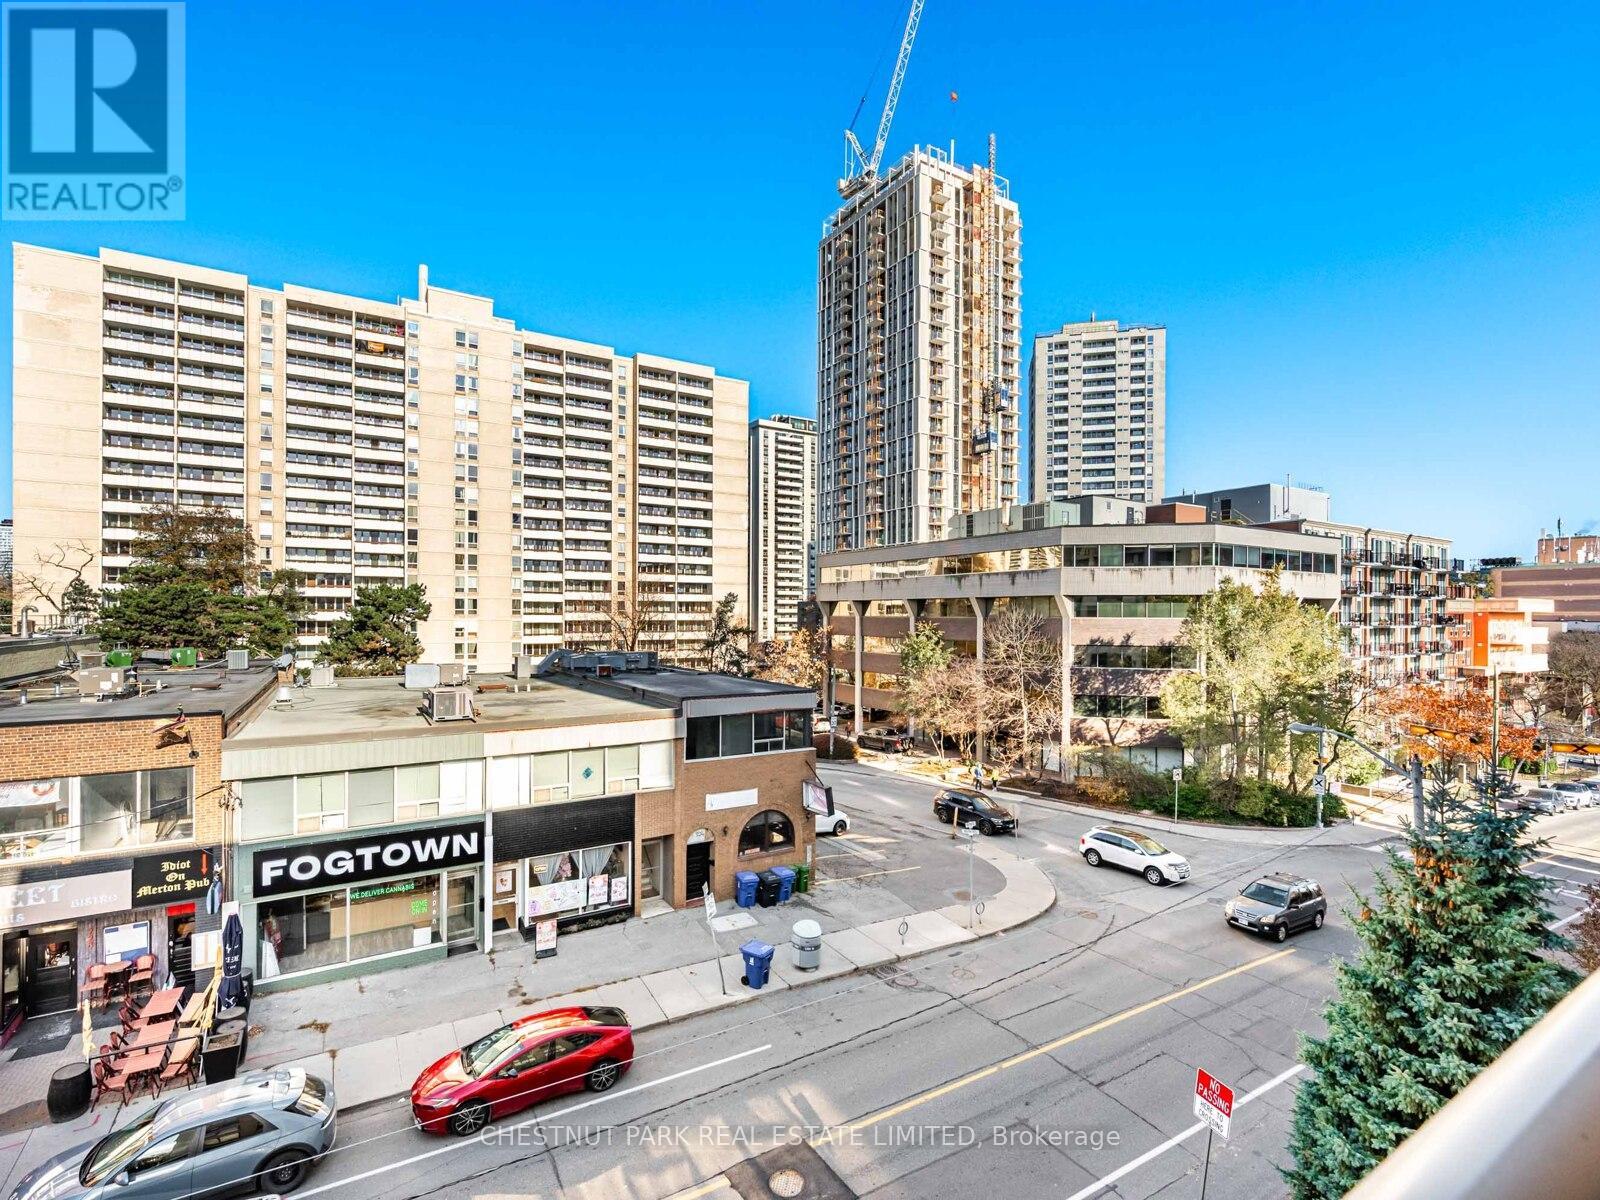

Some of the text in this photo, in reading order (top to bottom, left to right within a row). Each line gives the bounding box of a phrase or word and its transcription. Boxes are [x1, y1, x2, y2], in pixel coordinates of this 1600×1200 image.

[160, 860, 191, 872] Idiot
[261, 832, 478, 887] FOGTOWN
[165, 872, 185, 882] On
[136, 877, 210, 898] Merton Pub
[361, 887, 385, 898] DELIVER
[385, 883, 415, 894] CANNABIS
[1209, 1079, 1220, 1094] NO
[1198, 1083, 1230, 1114] PASSING
[1199, 1109, 1224, 1133] CROSSING
[1217, 1112, 1224, 1123] TO
